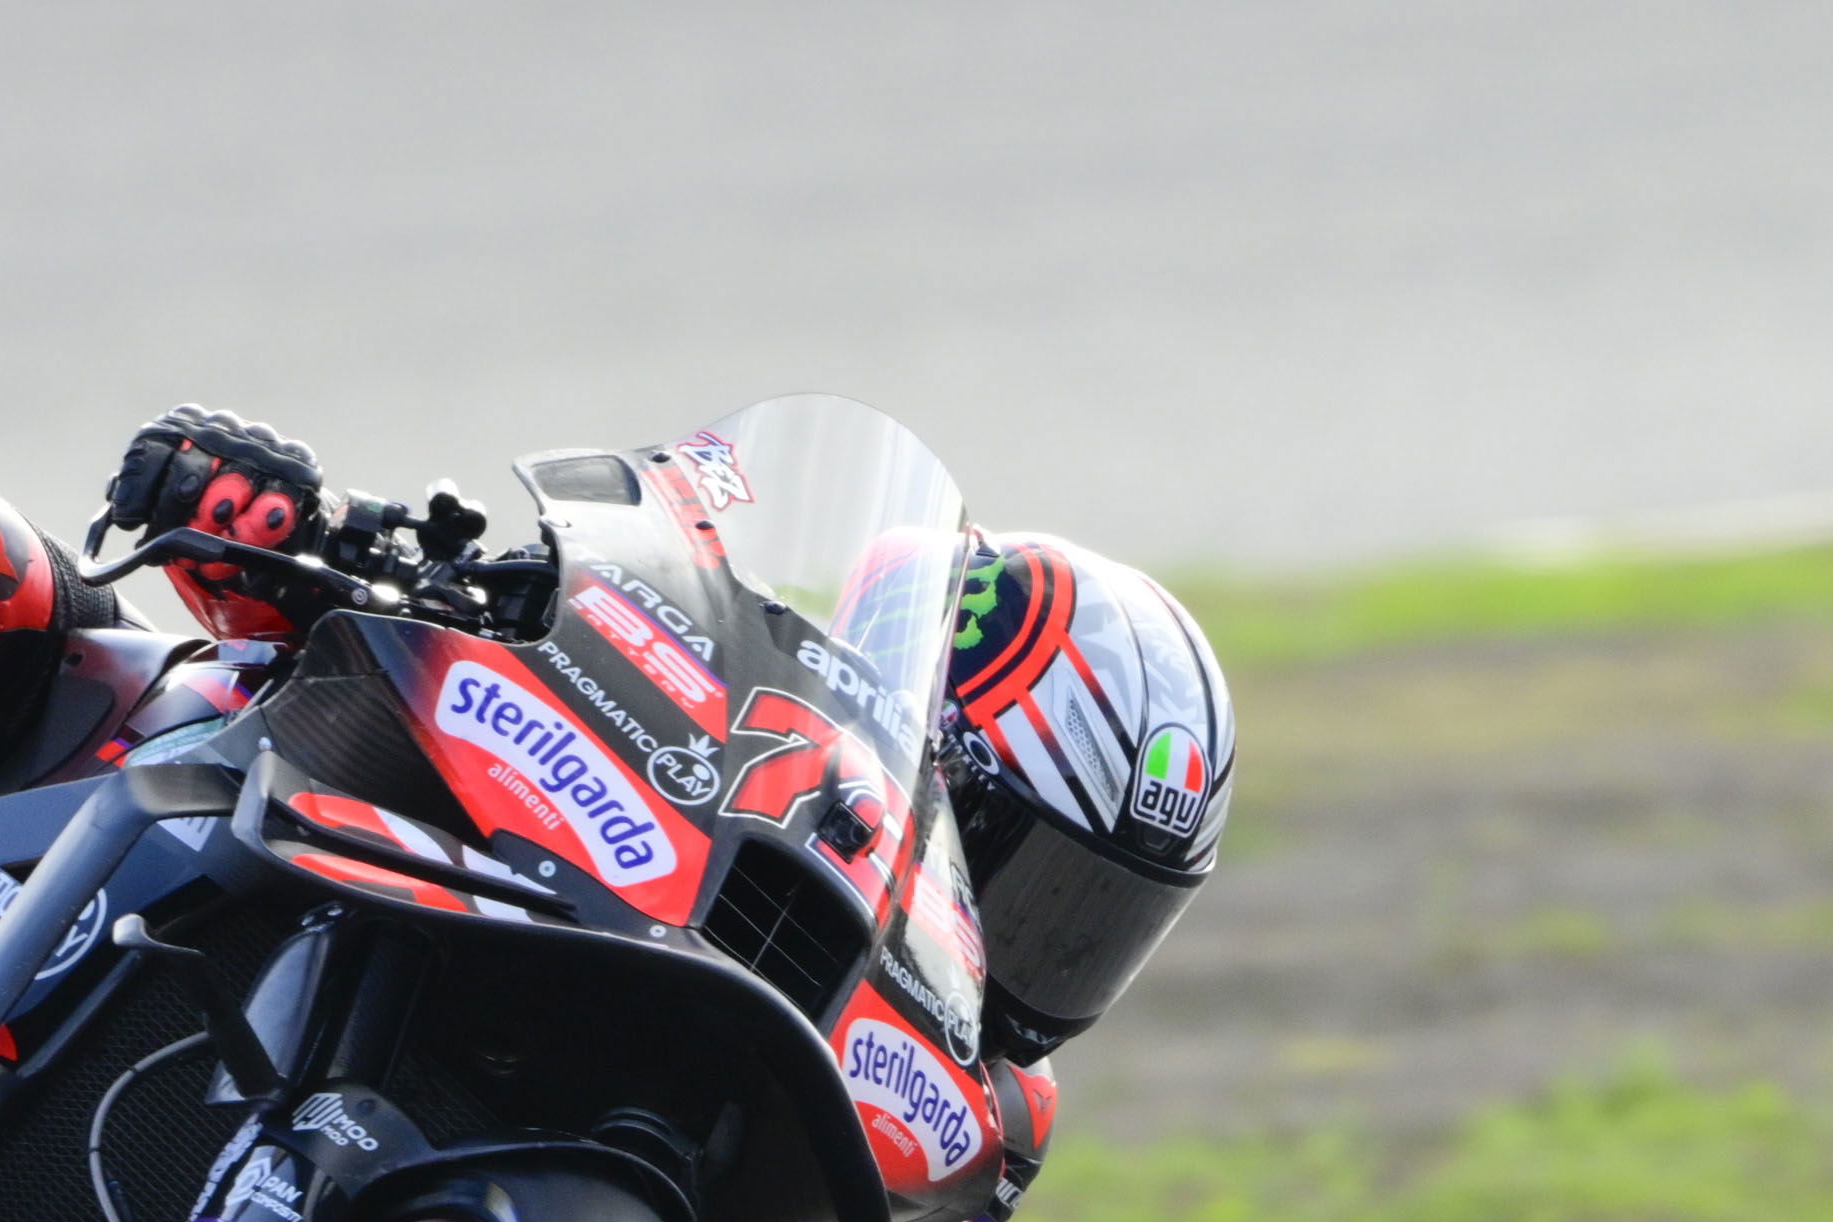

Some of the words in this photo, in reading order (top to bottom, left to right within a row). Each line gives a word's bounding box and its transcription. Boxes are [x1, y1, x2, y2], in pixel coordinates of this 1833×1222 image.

[575, 586, 717, 703] BS
[538, 641, 658, 753] PRAGMATIC
[656, 753, 712, 796] PLAY
[797, 640, 922, 768] aprilia
[451, 677, 656, 870] sterilgarda
[487, 763, 567, 831] alimenti
[1140, 779, 1197, 828] agv
[880, 944, 946, 1021] PRAGMATIC
[849, 1031, 971, 1168] sterilgarda
[872, 1113, 916, 1158] alimenti
